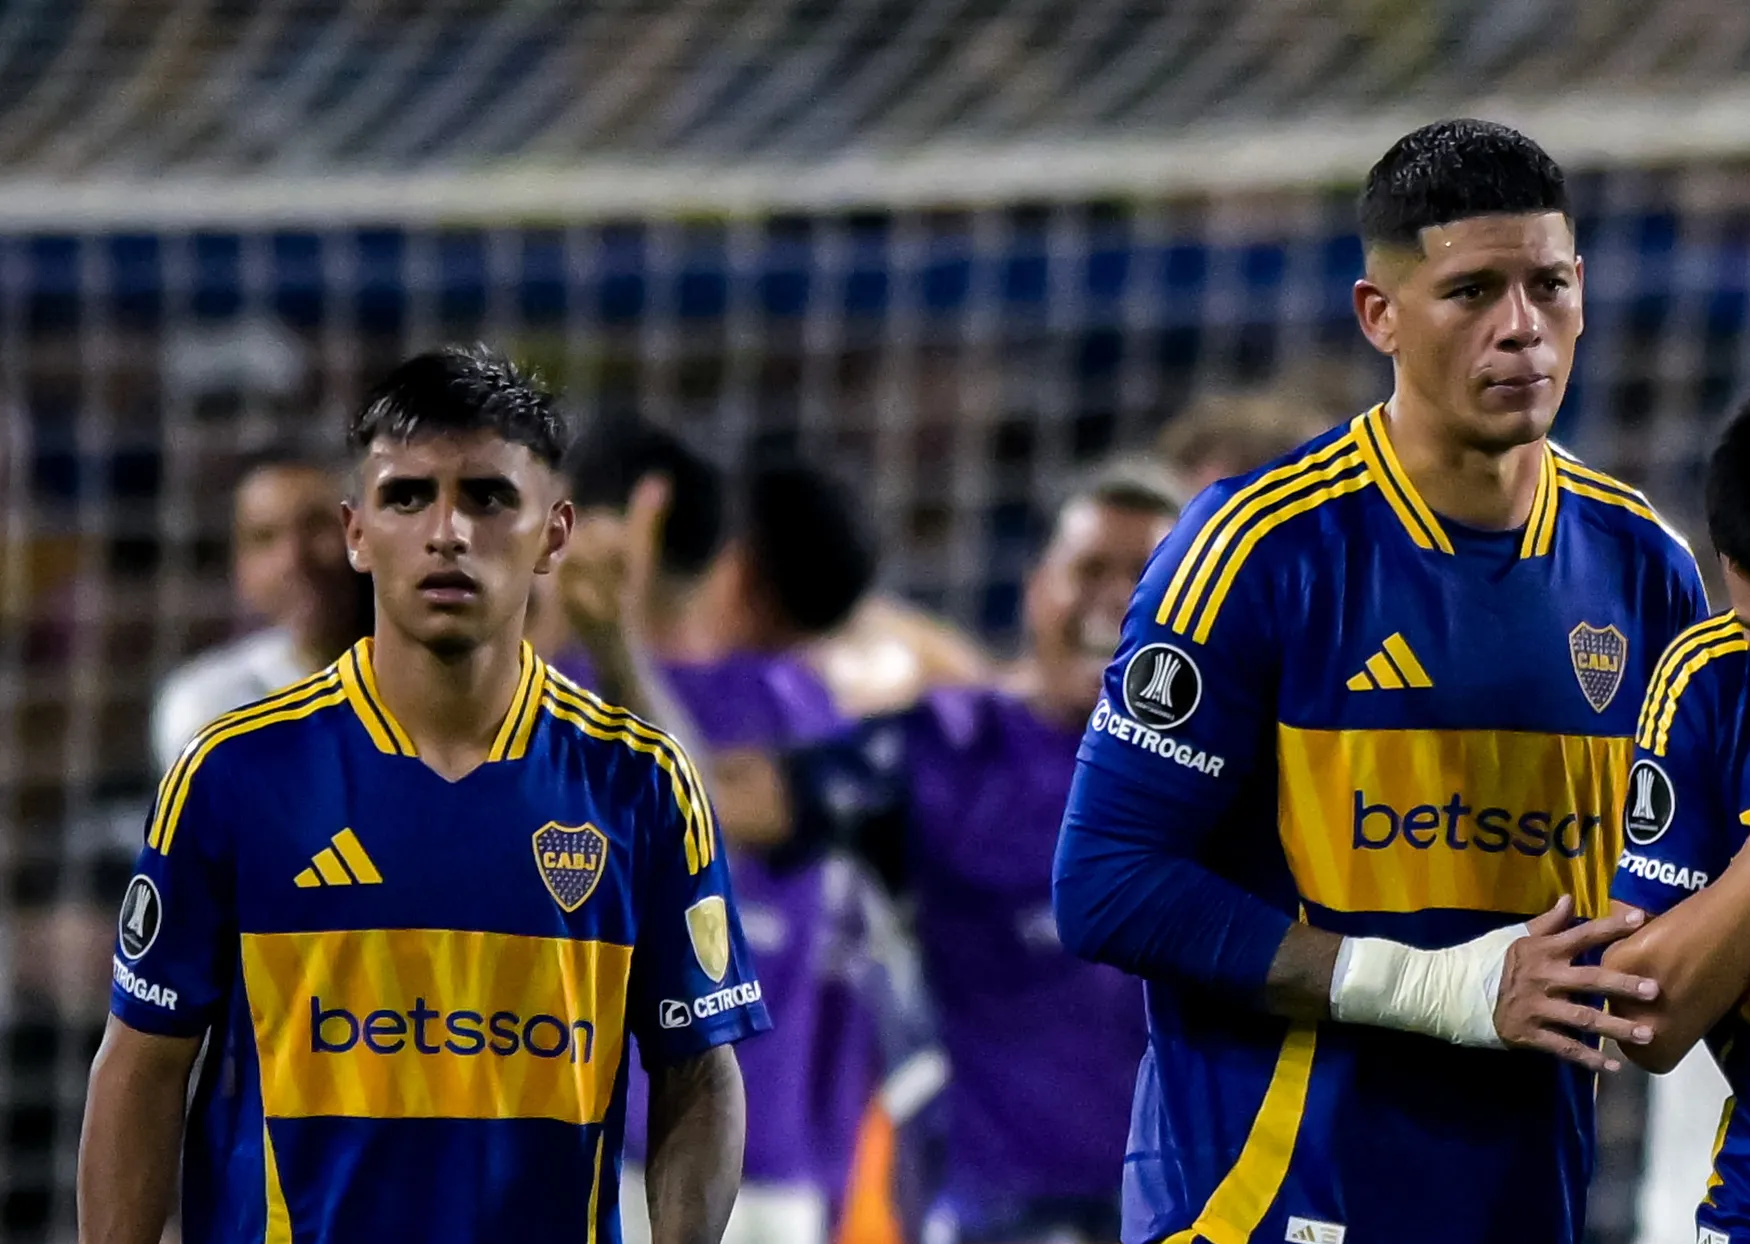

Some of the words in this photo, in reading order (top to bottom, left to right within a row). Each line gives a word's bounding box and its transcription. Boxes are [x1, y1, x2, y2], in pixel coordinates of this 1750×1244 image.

[1107, 713, 1225, 777] CETROGAR
[542, 851, 597, 871] CABJ
[309, 996, 594, 1064] betsson
